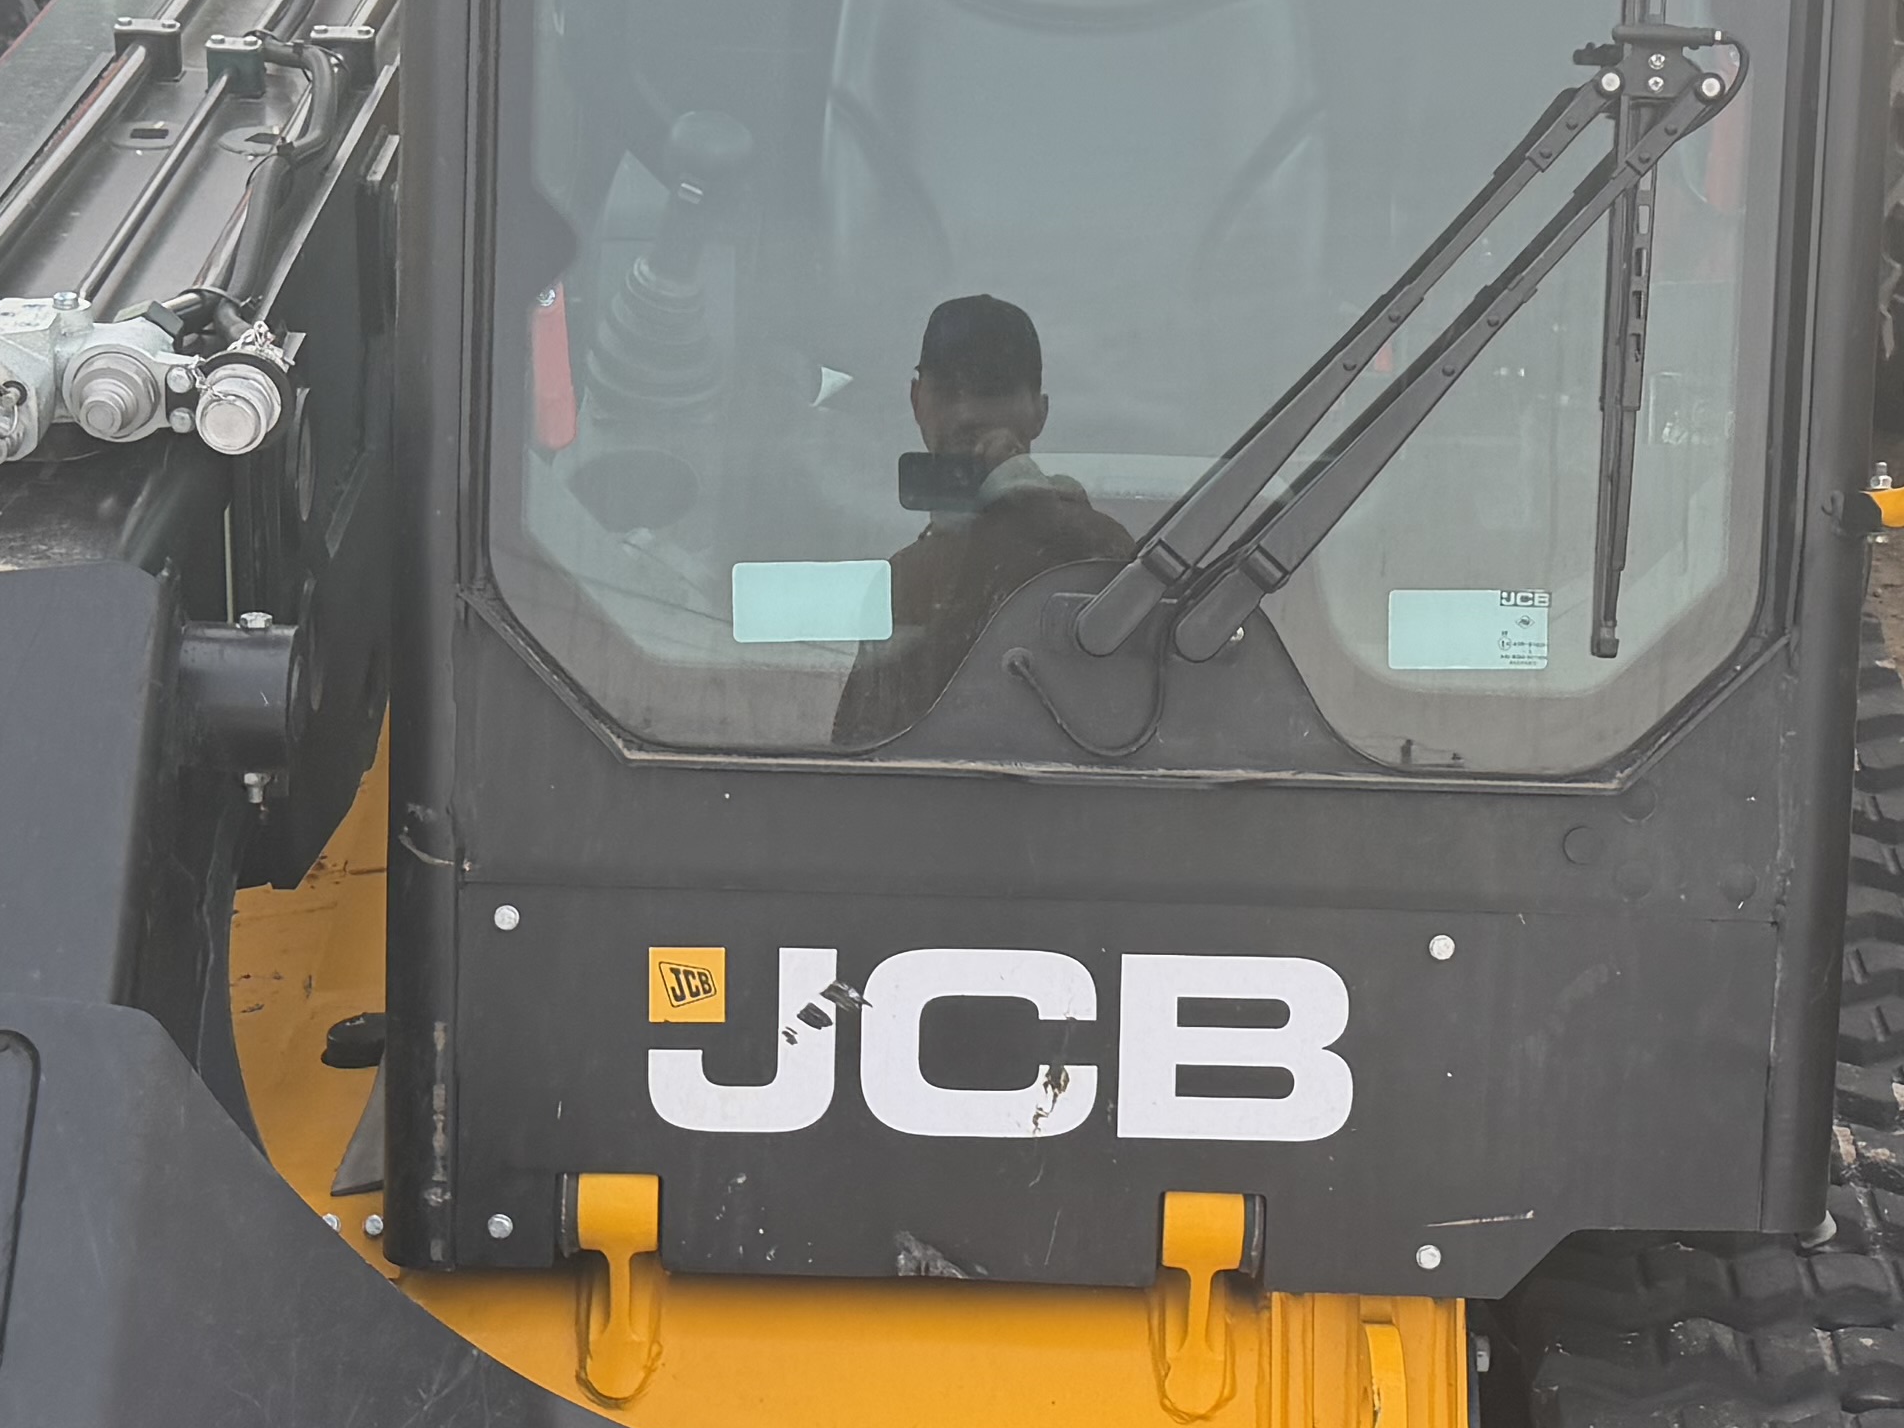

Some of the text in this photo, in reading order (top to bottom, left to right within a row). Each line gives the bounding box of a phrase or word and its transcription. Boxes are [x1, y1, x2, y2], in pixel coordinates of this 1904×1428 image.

[1501, 591, 1549, 606] JCB
[669, 967, 712, 1002] JCB
[647, 947, 1353, 1142] JCB
